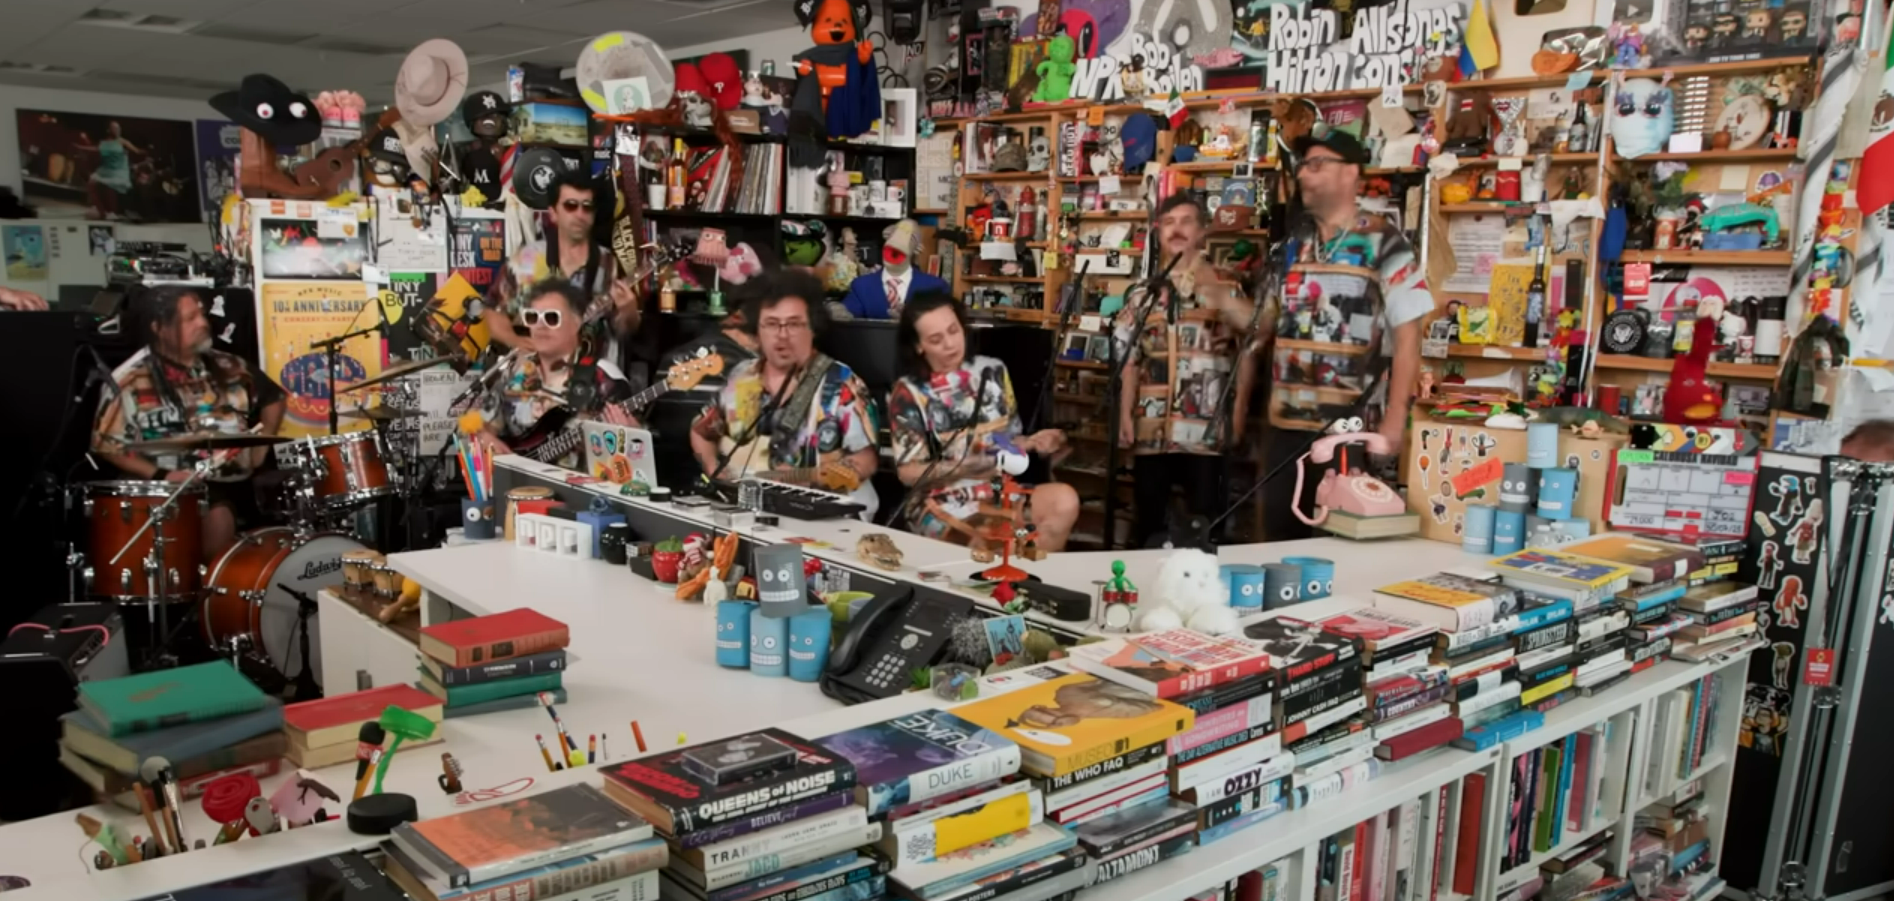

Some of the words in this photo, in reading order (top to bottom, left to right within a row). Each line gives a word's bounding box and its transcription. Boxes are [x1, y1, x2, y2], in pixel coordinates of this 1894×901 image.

[1269, 1, 1336, 51] Robin
[1132, 33, 1170, 69] Bob
[1267, 46, 1348, 93] Hilton
[1069, 54, 1131, 99] NPR
[1144, 54, 1202, 94] Boilen
[473, 168, 491, 183] M
[893, 712, 993, 755] DUKE
[928, 762, 974, 790] DUKE
[1054, 766, 1073, 787] THE
[1075, 761, 1100, 782] WHO
[1103, 756, 1124, 774] FAQ
[1224, 768, 1262, 797] OZZY
[699, 786, 771, 820] QUEENS
[785, 769, 836, 794] NOISE
[1098, 844, 1160, 881] ALTAMONT
